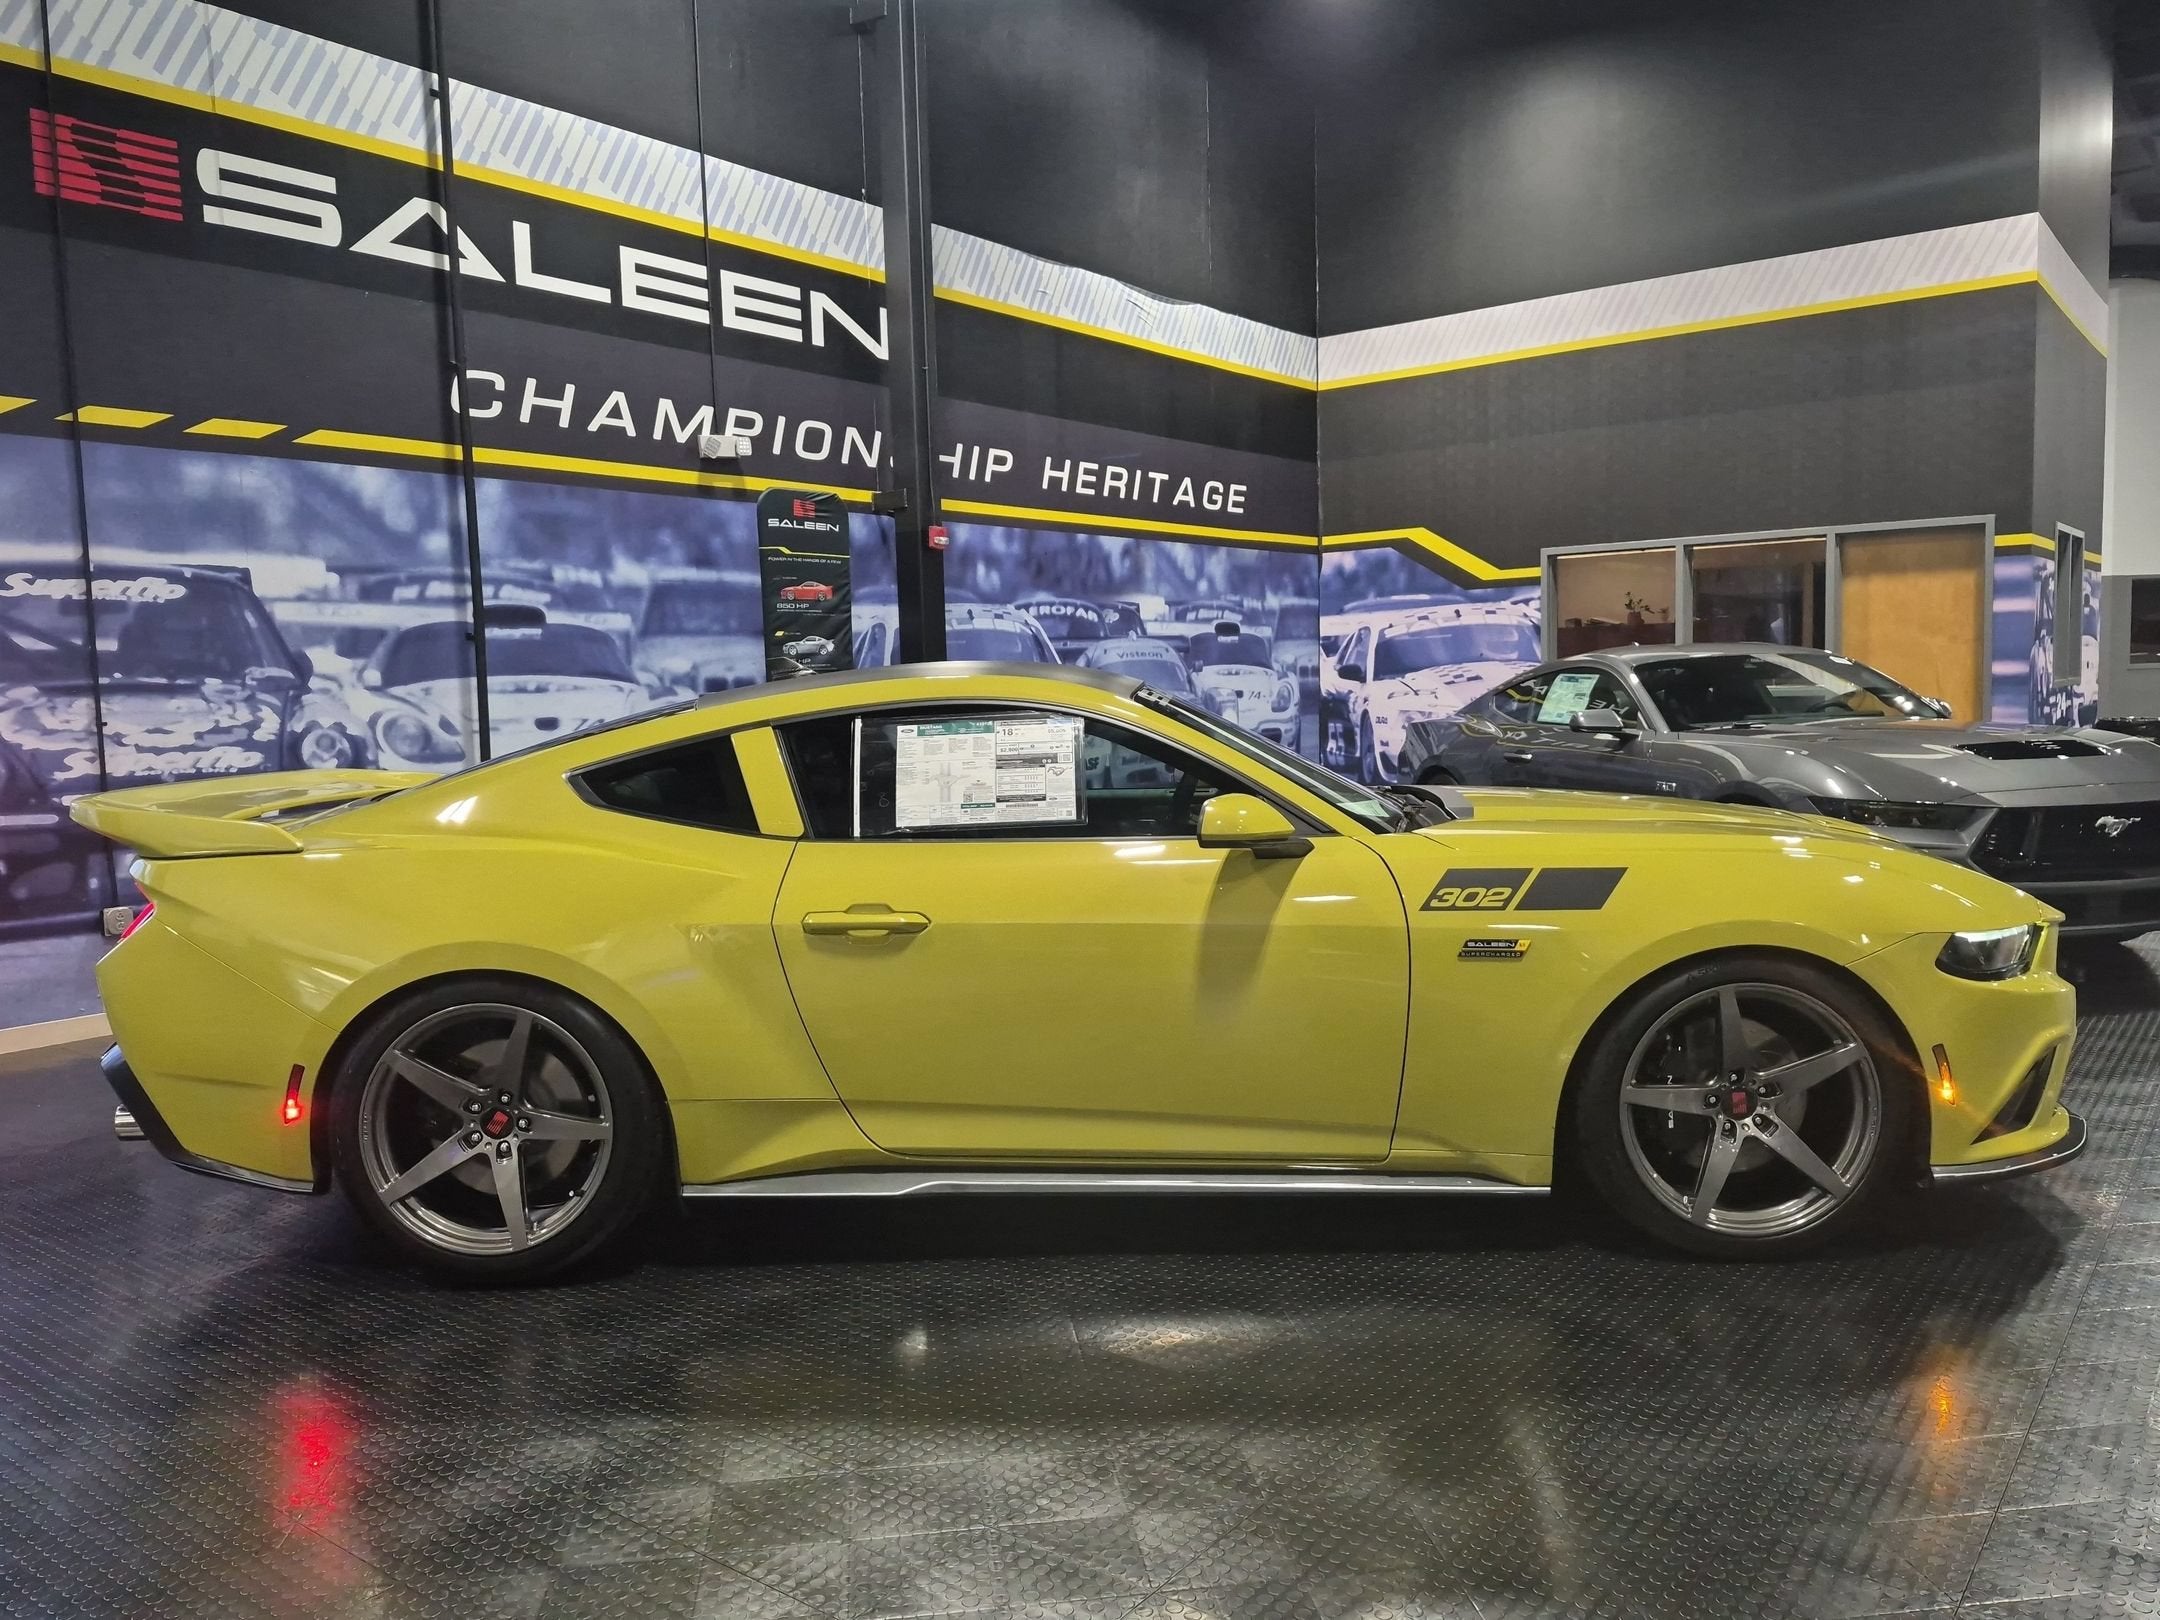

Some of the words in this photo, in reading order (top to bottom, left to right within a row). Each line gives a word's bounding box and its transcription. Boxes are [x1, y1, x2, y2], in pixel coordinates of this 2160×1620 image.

[196, 147, 888, 361] SALEEN
[450, 369, 1014, 482] CHAMPIONHIP
[1042, 456, 1248, 514] HERITAGE
[767, 518, 840, 532] SALEEN
[1116, 651, 1163, 659] Visteon
[1002, 728, 1014, 736] 18
[1430, 887, 1513, 907] 302
